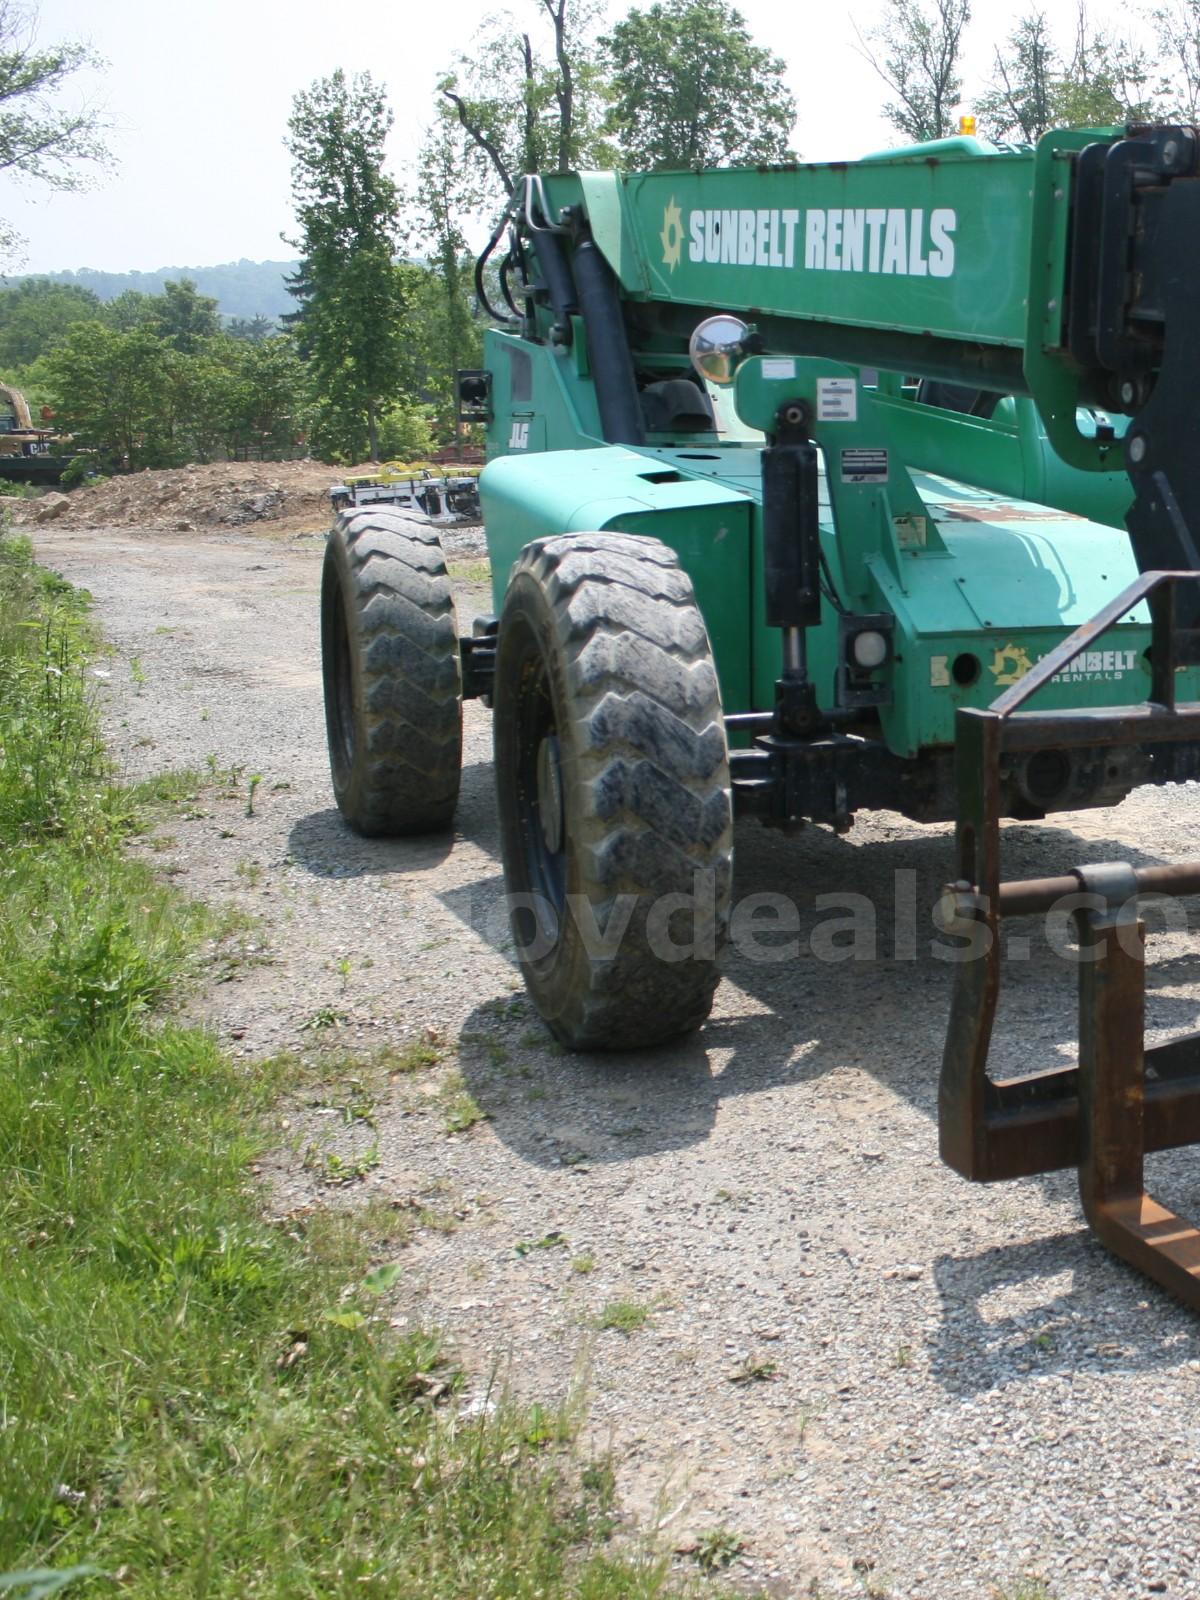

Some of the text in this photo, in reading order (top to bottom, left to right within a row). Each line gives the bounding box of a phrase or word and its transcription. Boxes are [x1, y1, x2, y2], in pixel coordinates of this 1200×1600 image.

[689, 208, 956, 278] SUNBELT RENTALS
[1038, 650, 1137, 673] NBELT
[1051, 672, 1123, 683] RENTALS
